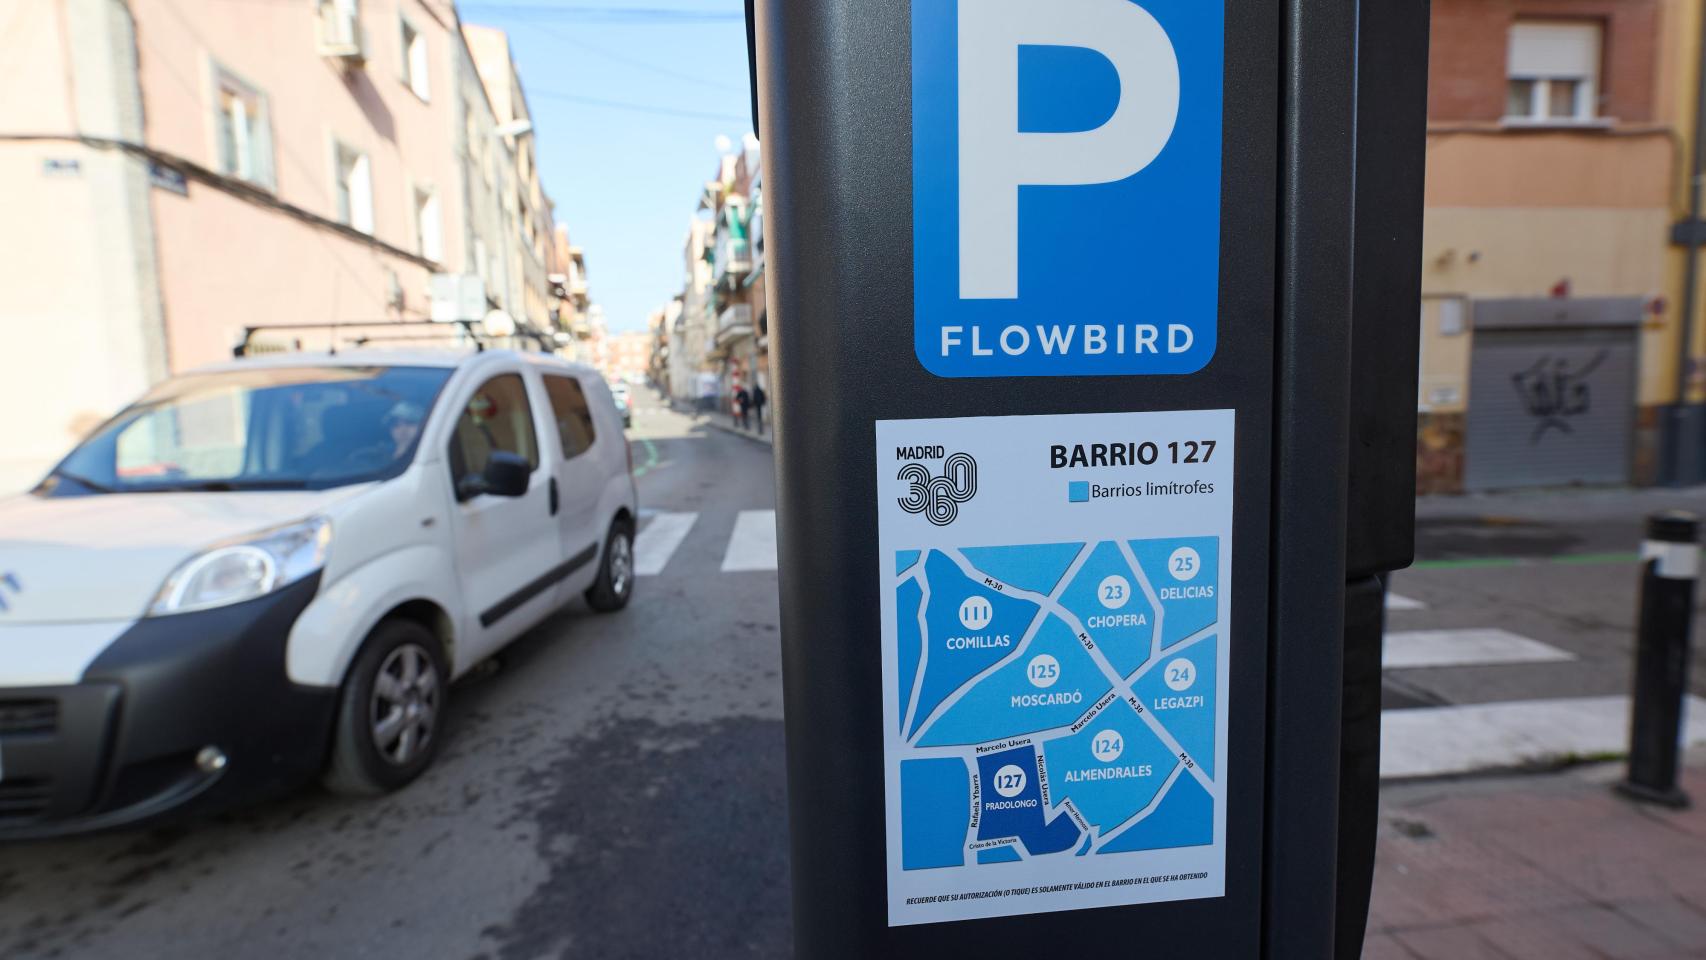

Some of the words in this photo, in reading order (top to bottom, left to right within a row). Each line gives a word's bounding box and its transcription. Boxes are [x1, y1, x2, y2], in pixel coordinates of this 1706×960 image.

[958, 0, 1180, 299] P
[941, 323, 1194, 357] FLOWBIRD
[896, 445, 945, 460] MADRID
[1050, 441, 1159, 468] BARRIO
[1168, 440, 1217, 464] 127
[1092, 484, 1142, 498] Barrios
[1146, 480, 1214, 496] limítrofes
[1175, 557, 1193, 572] 25
[984, 577, 1003, 591] M-30
[1104, 586, 1123, 600] 23
[1160, 586, 1214, 600] DELICIAS
[964, 606, 988, 621] 111
[1087, 615, 1147, 628] CHOPERA
[946, 634, 1010, 650] COMILLAS
[1079, 633, 1094, 650] M-30
[1031, 664, 1057, 679] 125
[1171, 667, 1190, 682] 24
[1011, 689, 1082, 707] MOSCARDÓ
[1128, 697, 1144, 714] M-30
[1154, 695, 1204, 710] LEGAZPI
[1070, 710, 1097, 733] Marcelo
[1095, 693, 1116, 711] Usera
[976, 743, 1007, 753] Marcelo
[1008, 738, 1031, 747] Usera
[1095, 739, 1120, 753] 124
[1179, 752, 1194, 769] M-30
[1037, 755, 1046, 782] Nicolás
[1064, 765, 1152, 782] ALMENDRALES
[998, 774, 1022, 788] 127
[985, 799, 1037, 810] PRADOLONGO
[971, 801, 980, 828] Rafaela
[906, 895, 937, 905] RECUERDE
[937, 894, 950, 903] QUE
[950, 893, 959, 901] SU
[959, 889, 1003, 901] AUTORIZACIÓN
[1003, 889, 1010, 898] (O
[1011, 888, 1030, 896] TIQUE)
[1039, 883, 1073, 893] SOLAMENTE
[1073, 881, 1095, 890] VÁLIDO
[1104, 880, 1111, 888] EL
[1111, 878, 1134, 886] BARRIO
[1143, 876, 1150, 884] EL
[1150, 875, 1162, 884] QUE
[1179, 872, 1208, 880] OBTENIDO
